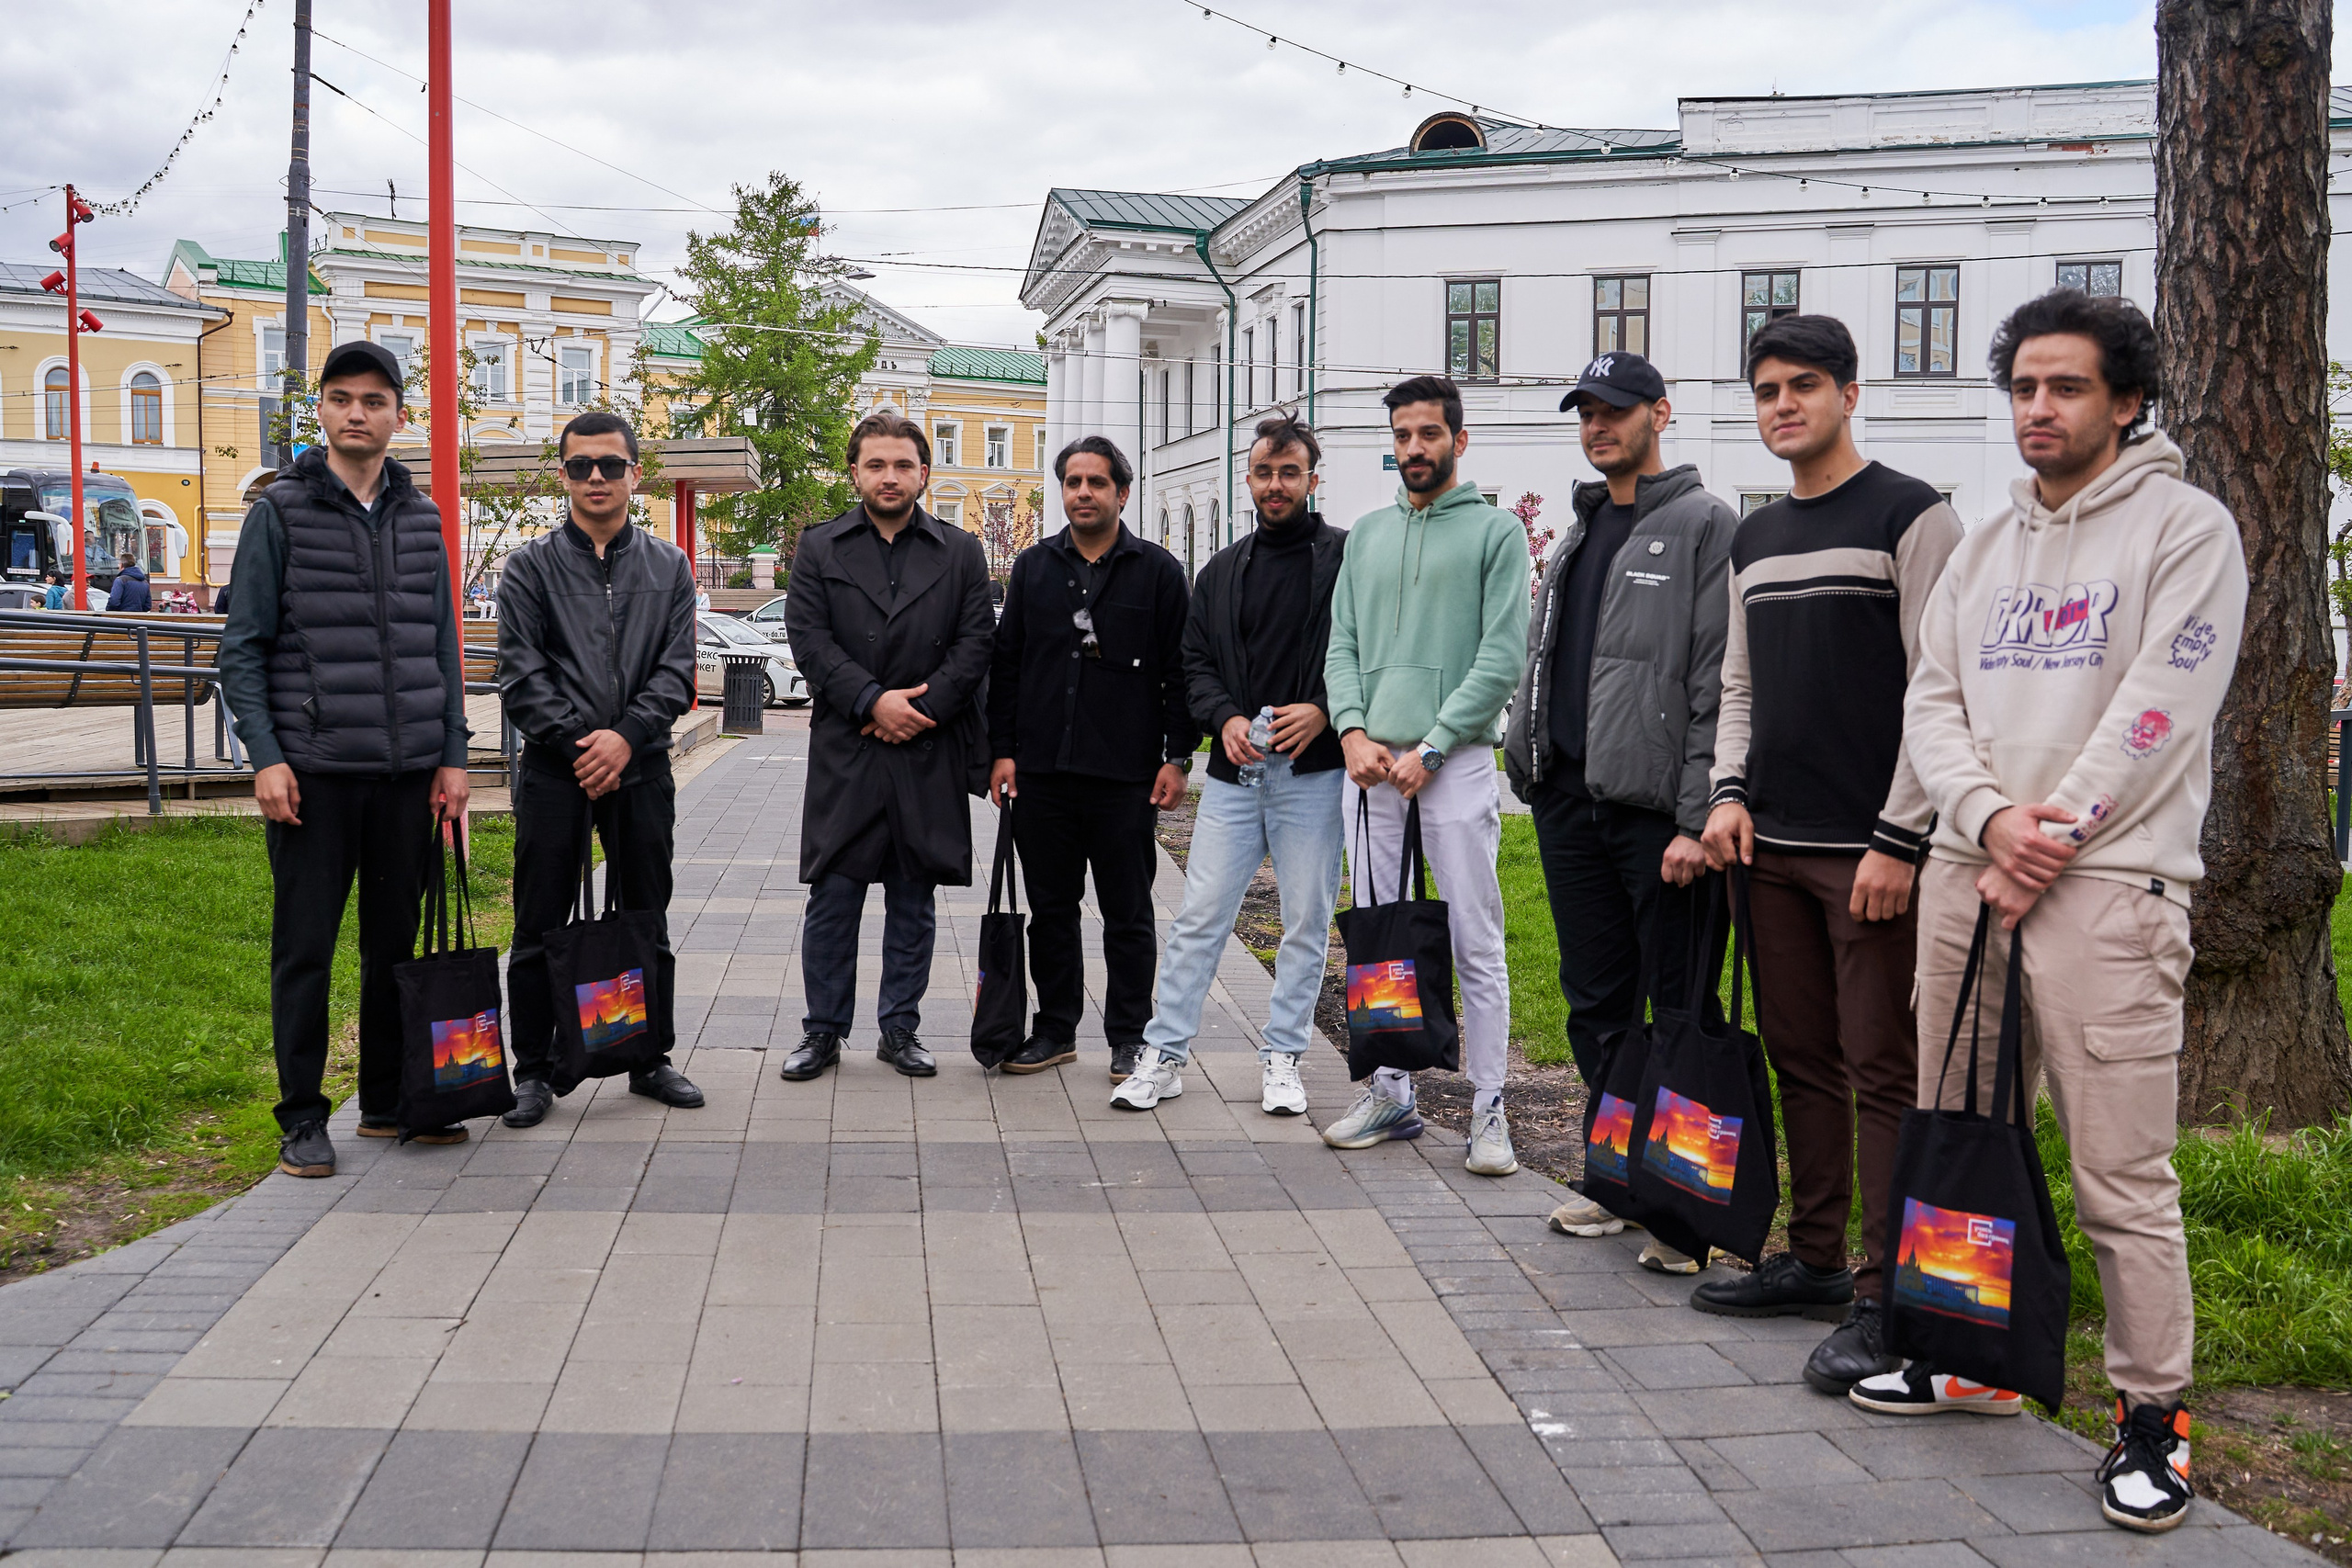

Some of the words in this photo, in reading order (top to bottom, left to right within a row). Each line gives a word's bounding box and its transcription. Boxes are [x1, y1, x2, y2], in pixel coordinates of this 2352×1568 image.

[872, 359, 898, 369] УДЪ
[1589, 356, 1615, 378] NY
[1981, 579, 2119, 649] ERROR
[2182, 614, 2216, 645] Video
[695, 649, 718, 660] декс
[2170, 634, 2212, 661] Empty
[2010, 652, 2034, 669] Soul
[2041, 657, 2061, 671] New
[2167, 649, 2199, 672] Soul
